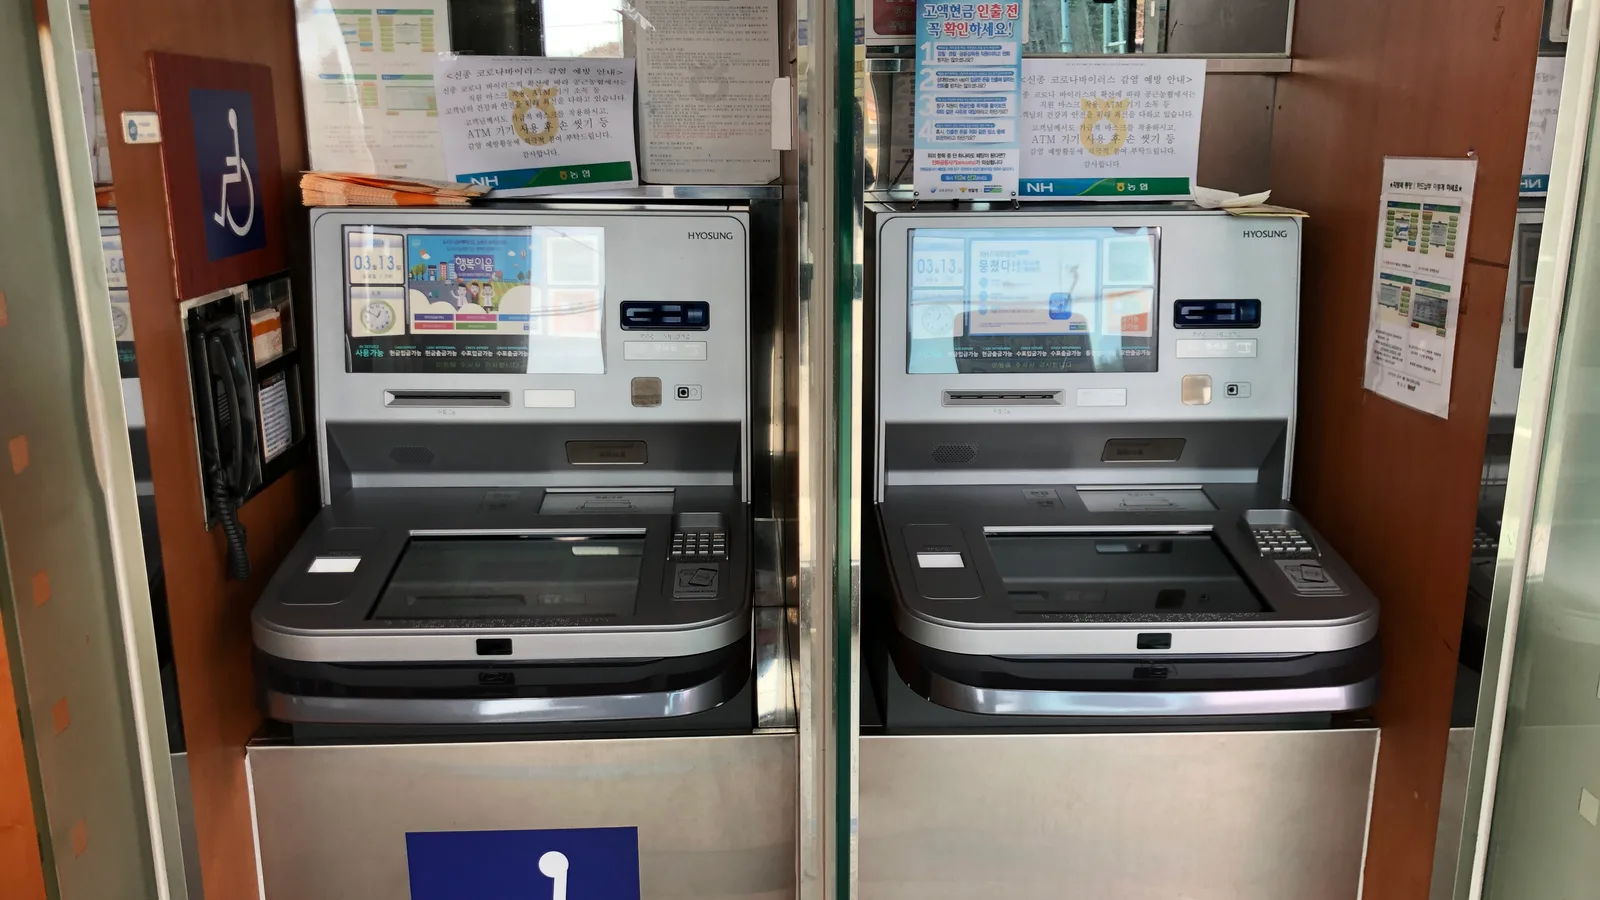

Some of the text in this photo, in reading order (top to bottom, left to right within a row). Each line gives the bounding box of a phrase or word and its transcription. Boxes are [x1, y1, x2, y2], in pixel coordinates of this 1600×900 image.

[924, 4, 974, 19] 고액현금
[977, 4, 1002, 19] 인출
[1006, 4, 1019, 19] 전
[928, 22, 1013, 37] 꼭 확인하세요!
[476, 68, 542, 77] 코로나바이러스
[1051, 74, 1116, 85] 코로나바이러스
[1121, 75, 1139, 85] 감염
[1144, 75, 1162, 85] 예방
[1167, 75, 1193, 85] 안내>
[1034, 90, 1055, 98] 코로나
[1060, 90, 1097, 99] 바이러스의
[1058, 100, 1080, 108] 마스크
[1020, 111, 1043, 119] 객님의
[1047, 111, 1068, 119] 건강과
[1139, 110, 1161, 118] 다하고
[468, 117, 609, 139] ATM 기기 사용 후 손 씻기 등
[1032, 124, 1075, 132] 고객님께서도
[1032, 134, 1175, 145] ATM 기기 사용 후 손 씻기 등
[522, 149, 560, 159] 감사합니다.
[1084, 160, 1122, 169] 감사합니다.
[570, 170, 591, 179] 농협
[471, 176, 499, 186] NH
[1027, 182, 1054, 193] NH
[1128, 183, 1149, 192] 농협
[688, 232, 733, 240] HYOSUNG
[1243, 230, 1288, 238] HYOSUNG
[455, 257, 494, 272] 행복이음
[355, 349, 385, 358] 사용가능
